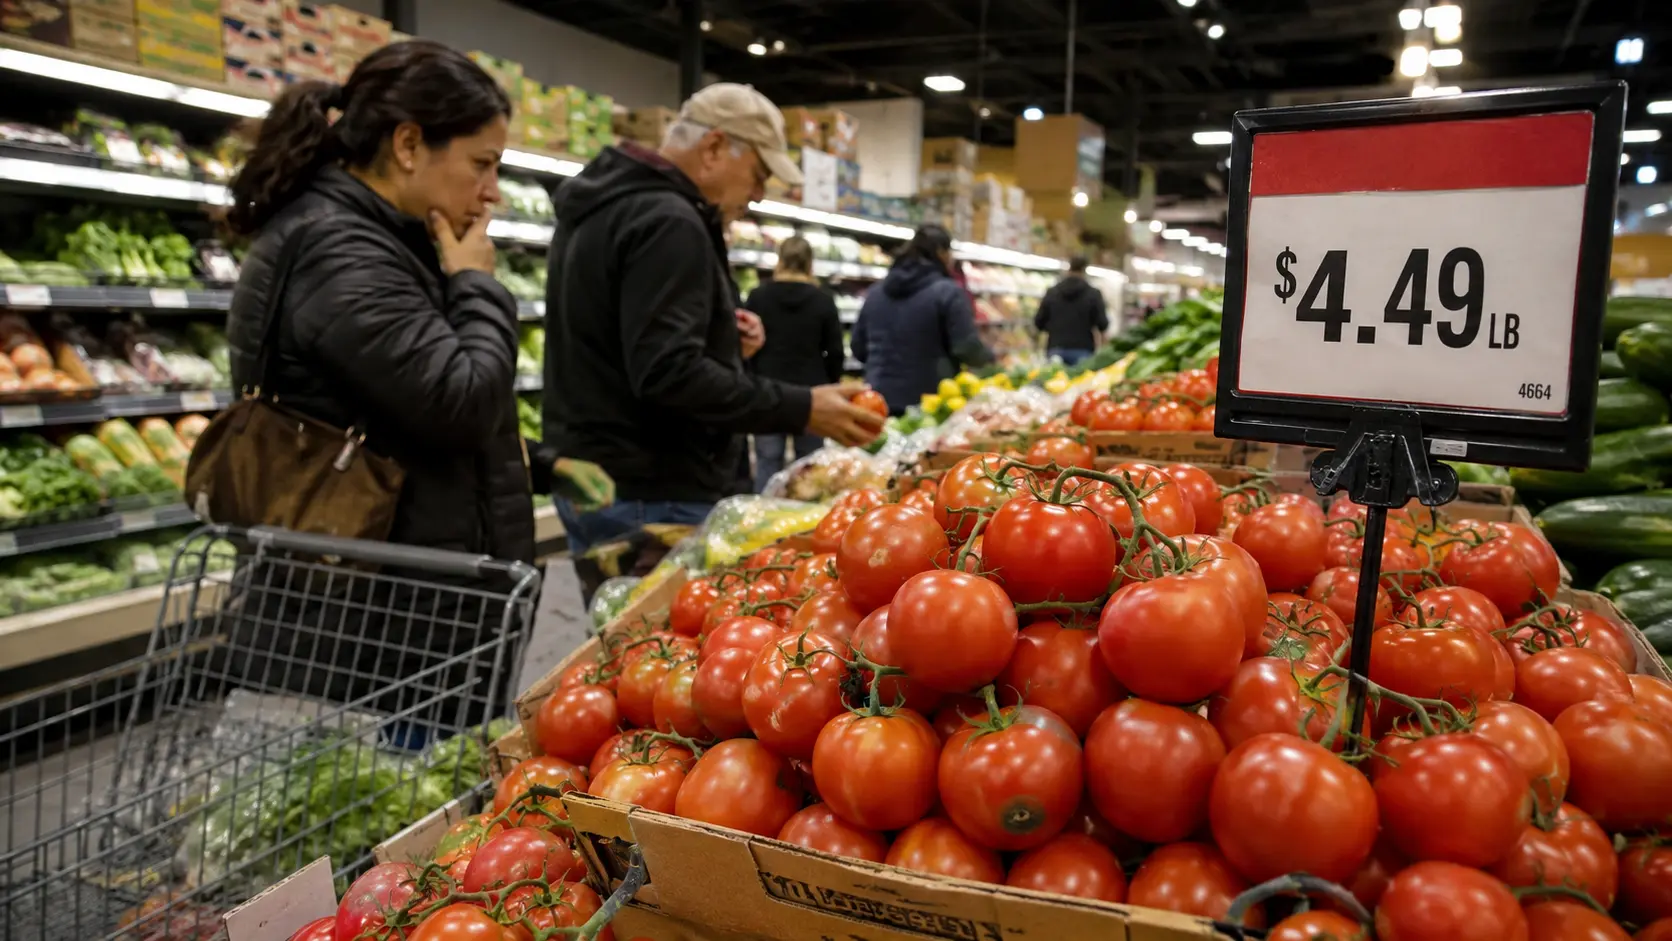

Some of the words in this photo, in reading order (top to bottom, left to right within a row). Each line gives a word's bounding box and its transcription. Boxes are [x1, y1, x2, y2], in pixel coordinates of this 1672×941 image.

[1274, 246, 1485, 349] $4.49
[1488, 312, 1520, 350] LB
[1518, 382, 1552, 400] 4664
